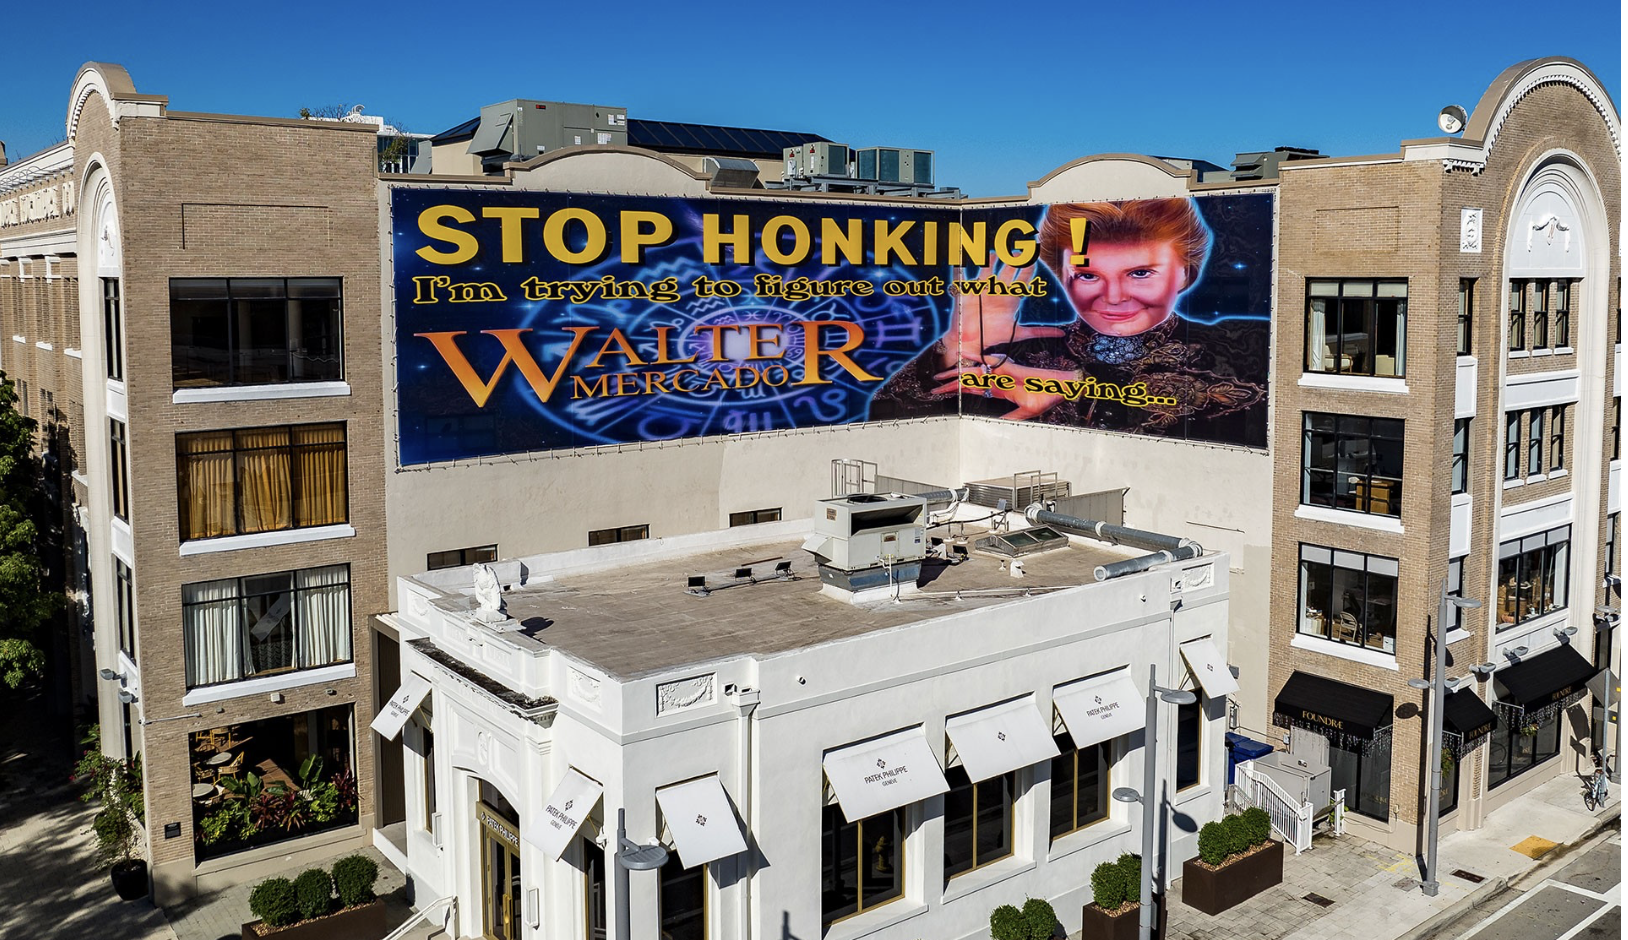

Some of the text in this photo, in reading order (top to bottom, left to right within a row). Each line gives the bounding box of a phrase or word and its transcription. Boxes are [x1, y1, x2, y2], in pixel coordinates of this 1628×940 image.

[415, 204, 673, 266] STOP
[702, 213, 1038, 267] HONKING
[412, 273, 1048, 305] I'm trying to figure out what
[413, 320, 885, 408] WALTER
[570, 365, 789, 400] MERCADO
[961, 371, 1177, 408] are saying...
[1086, 701, 1120, 717] PATEK PHILIPPE
[864, 765, 908, 784] PATEK PHILIPPE
[487, 815, 519, 847] PATEK PHILIPPE
[545, 804, 578, 830] PATEK PHILIPPE
